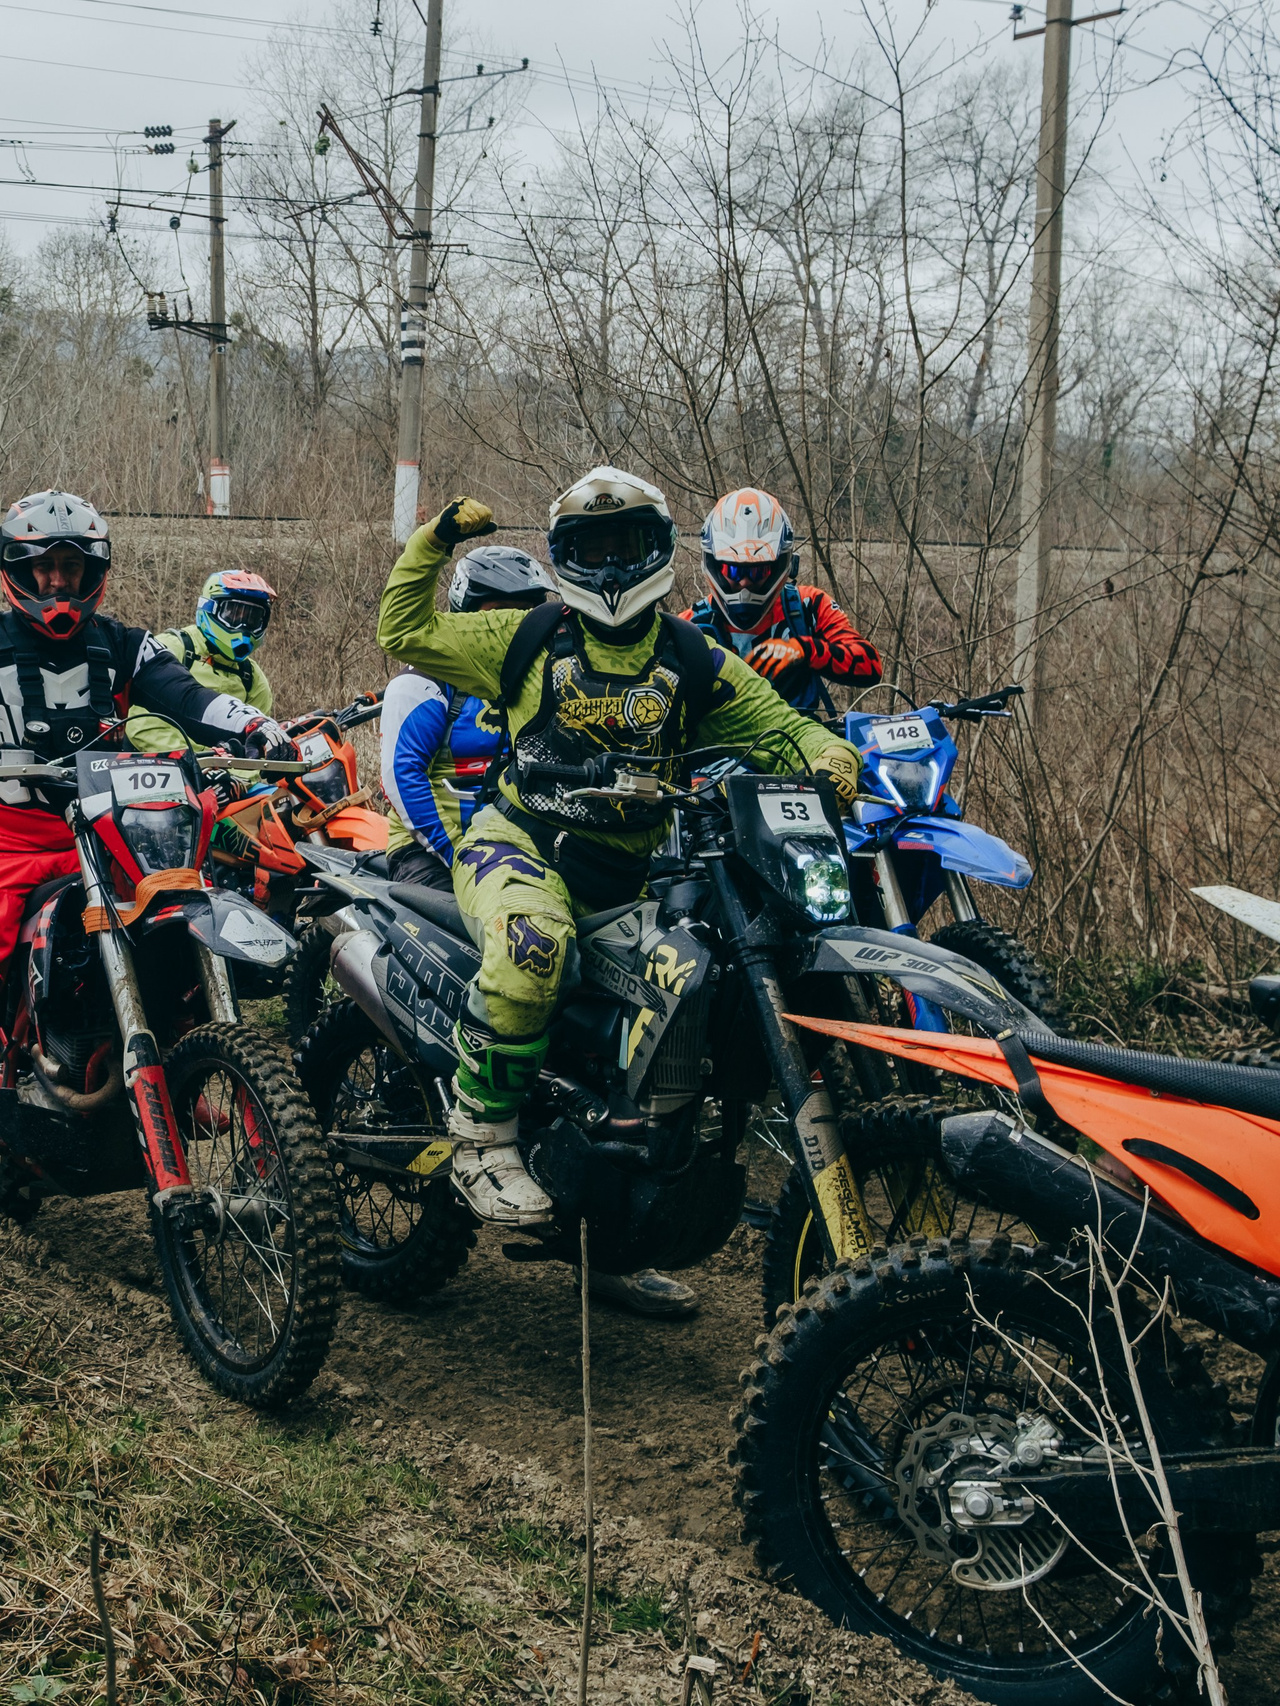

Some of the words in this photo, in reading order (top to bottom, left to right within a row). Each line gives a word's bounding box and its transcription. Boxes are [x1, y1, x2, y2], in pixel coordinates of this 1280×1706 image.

[886, 726, 920, 741] 148
[128, 772, 171, 790] 107
[828, 774, 859, 804] FOX
[780, 801, 810, 821] 53
[854, 947, 902, 962] WP
[901, 958, 941, 973] 300
[803, 1135, 826, 1170] DID
[836, 1165, 869, 1256] REGULMOT
